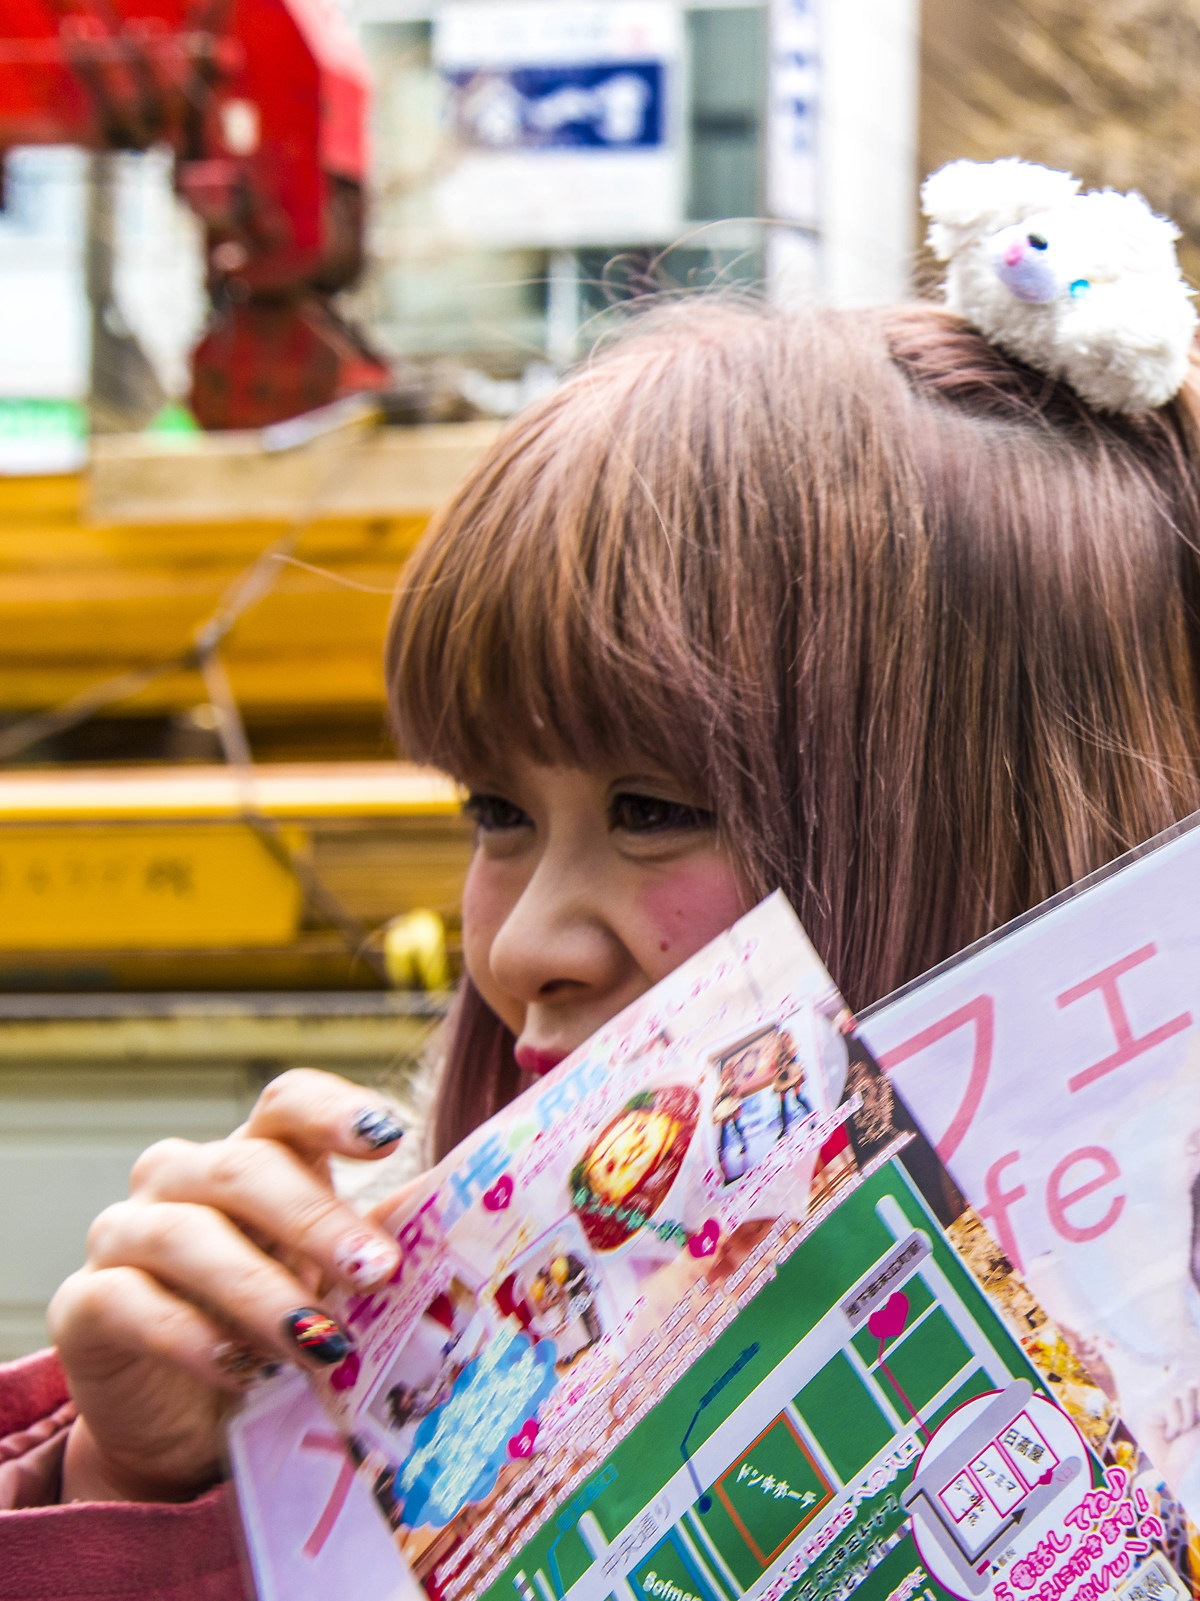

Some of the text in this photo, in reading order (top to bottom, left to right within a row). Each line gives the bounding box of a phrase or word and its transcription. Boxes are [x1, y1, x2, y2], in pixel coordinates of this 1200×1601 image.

[1003, 1428, 1046, 1464] 日高屋
[736, 1464, 816, 1509] ドンキホーテ
[976, 1461, 1016, 1493] ファミマ
[602, 1494, 671, 1579] 中央通り
[803, 1504, 854, 1561] Hearts
